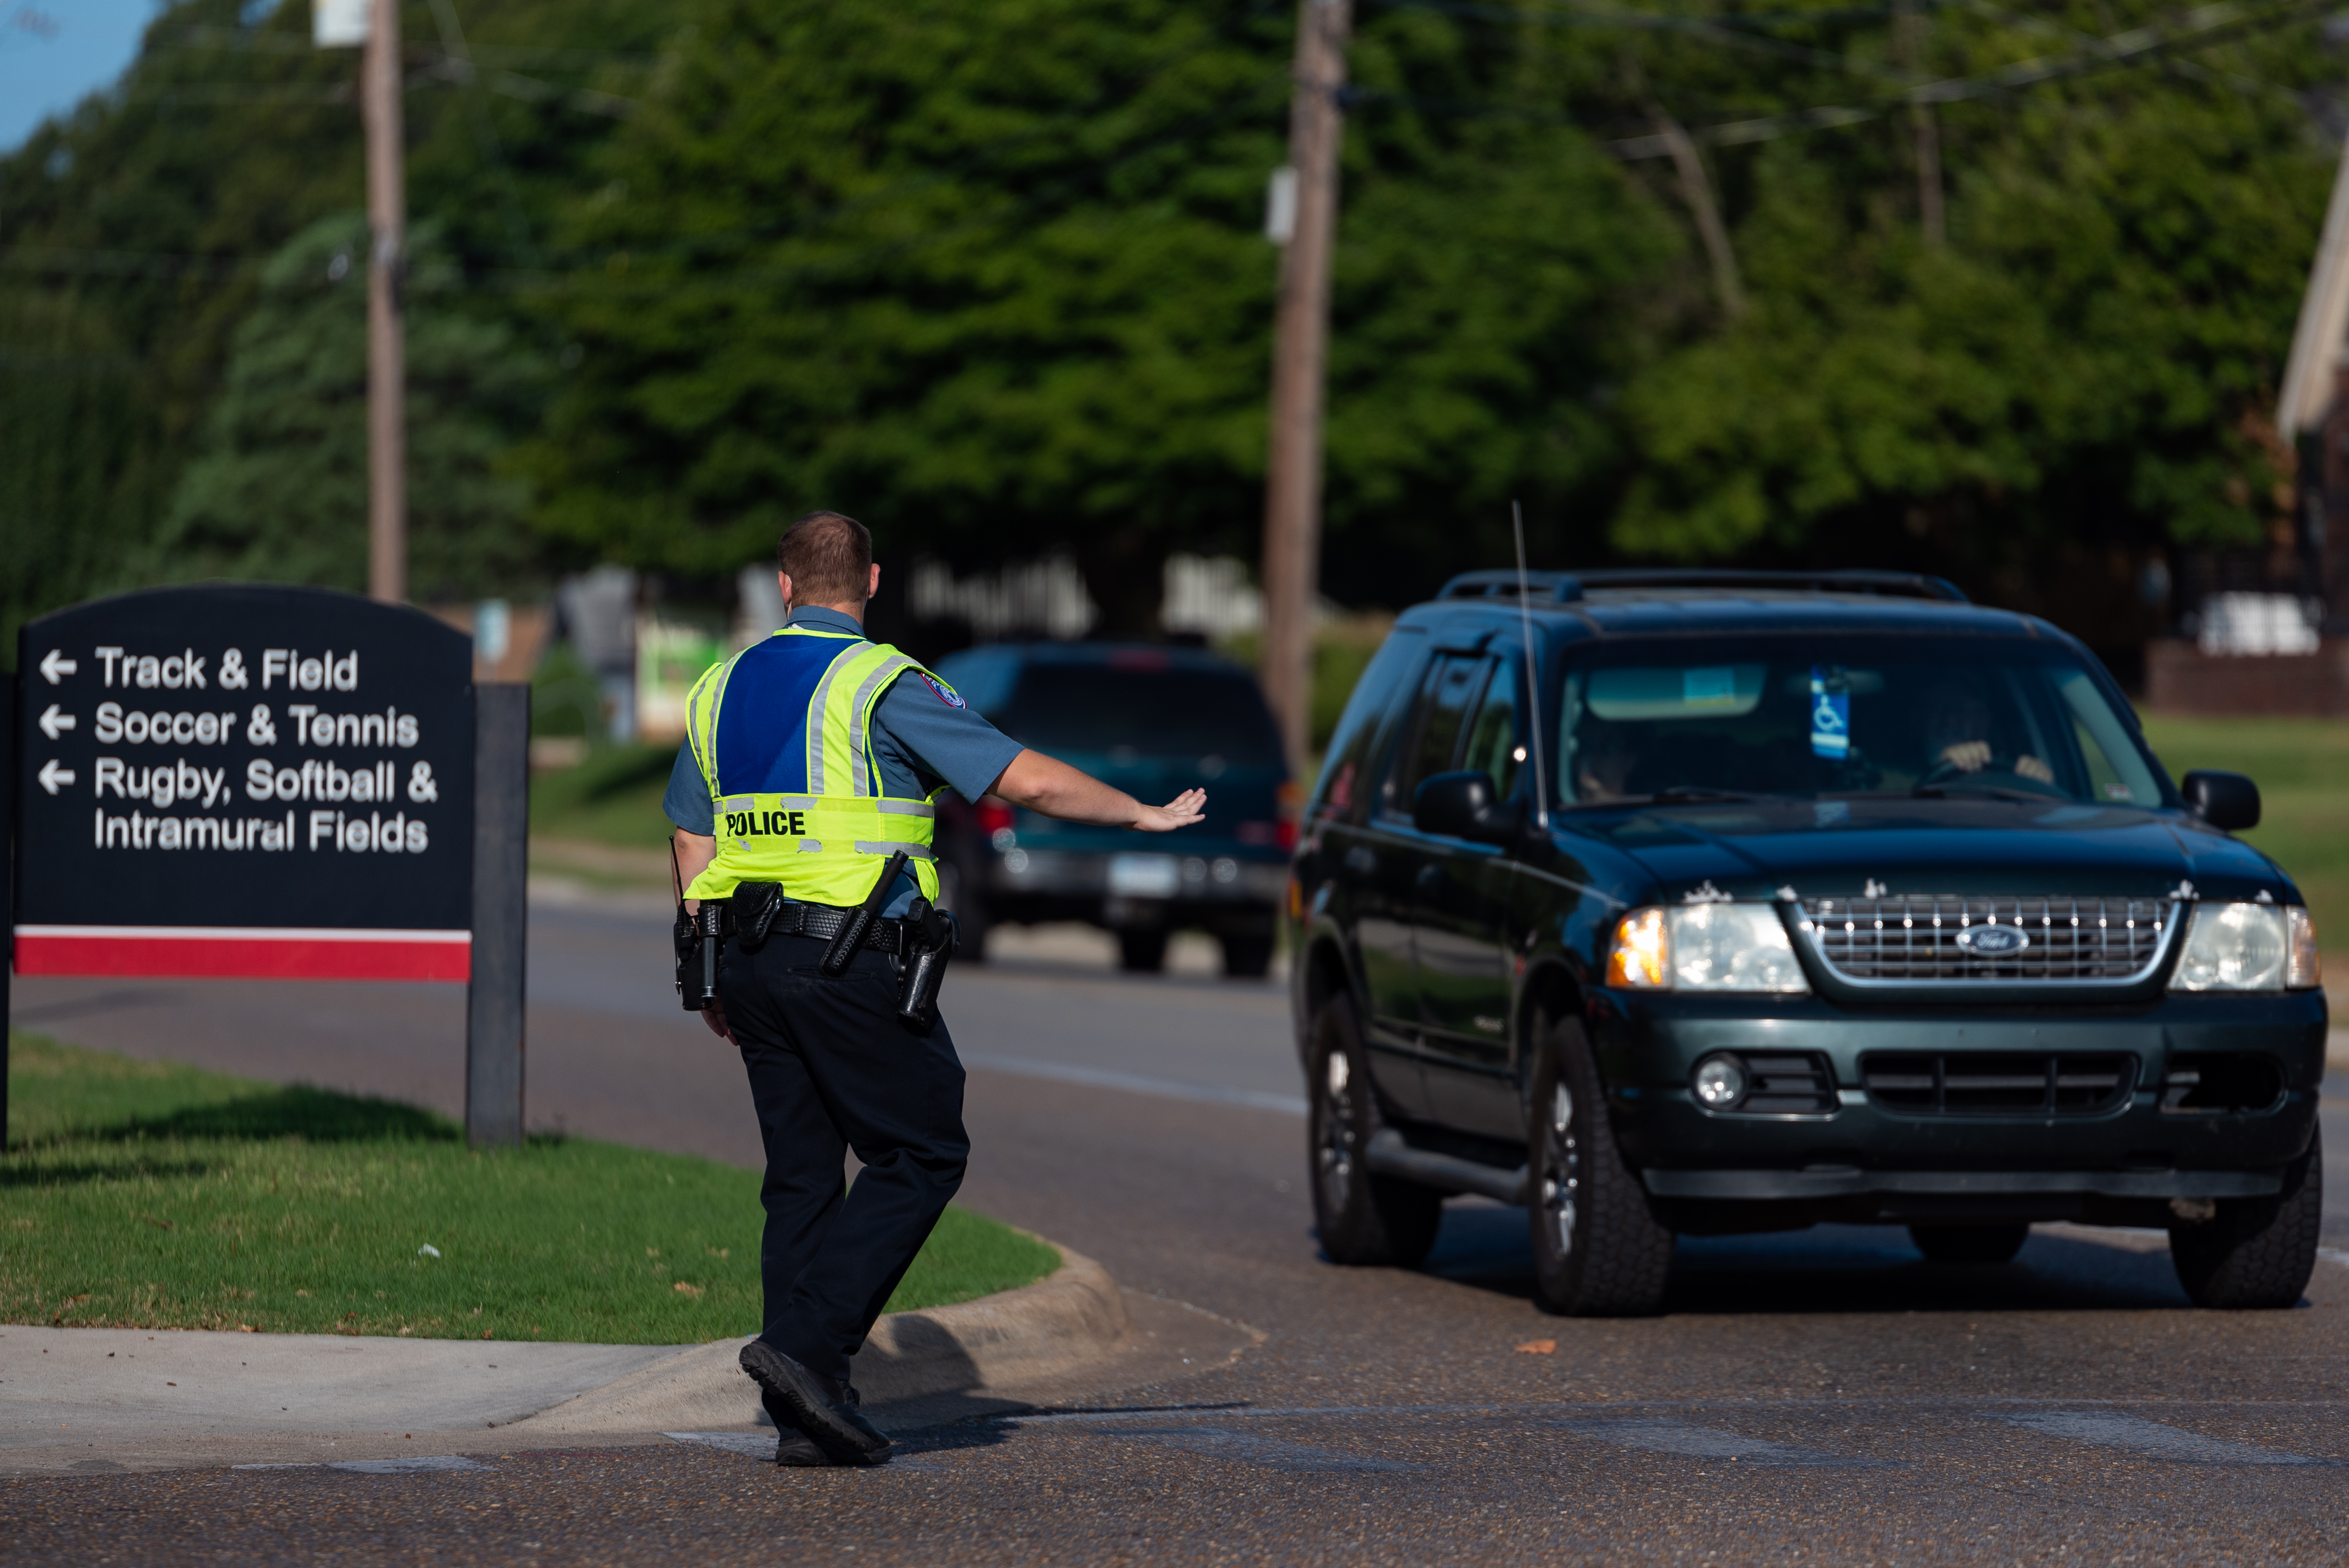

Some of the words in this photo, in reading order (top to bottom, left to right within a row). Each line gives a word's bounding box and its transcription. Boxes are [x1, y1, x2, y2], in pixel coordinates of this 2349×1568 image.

[95, 646, 207, 688] Track
[219, 648, 248, 689] &
[262, 649, 358, 691] Field
[95, 702, 236, 745] Soccer
[247, 704, 277, 745] &
[288, 705, 419, 747] Tennis
[95, 757, 231, 808] Rugby,
[246, 759, 395, 802] Softball
[408, 761, 438, 802] &
[95, 808, 295, 851] Intramural
[309, 810, 428, 853] Fields
[726, 811, 805, 837] POLICE
